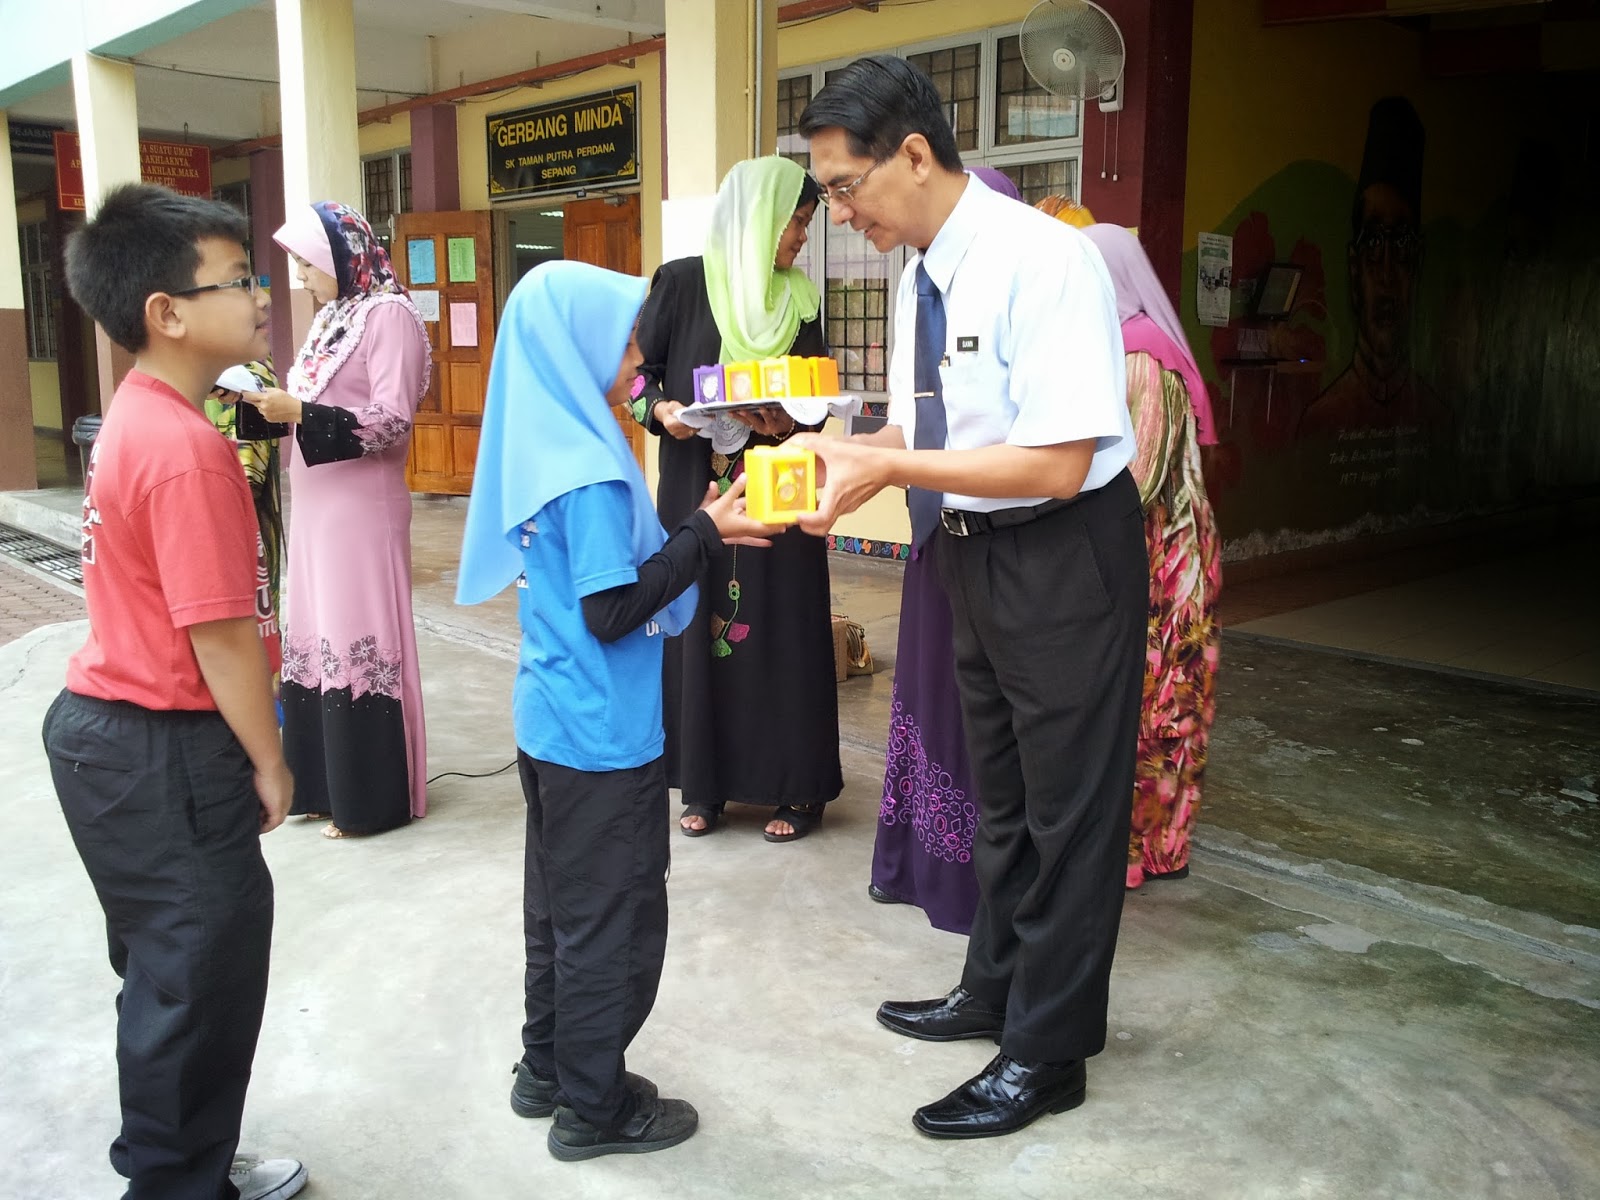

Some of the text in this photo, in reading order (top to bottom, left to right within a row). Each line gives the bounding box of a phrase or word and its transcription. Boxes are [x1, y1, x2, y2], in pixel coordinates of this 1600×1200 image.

[497, 103, 623, 147] GERBANG MINDA
[172, 146, 194, 158] UMAT
[505, 142, 615, 169] SK TAMAN PUTRA PERDANA
[541, 165, 577, 180] SEPANG
